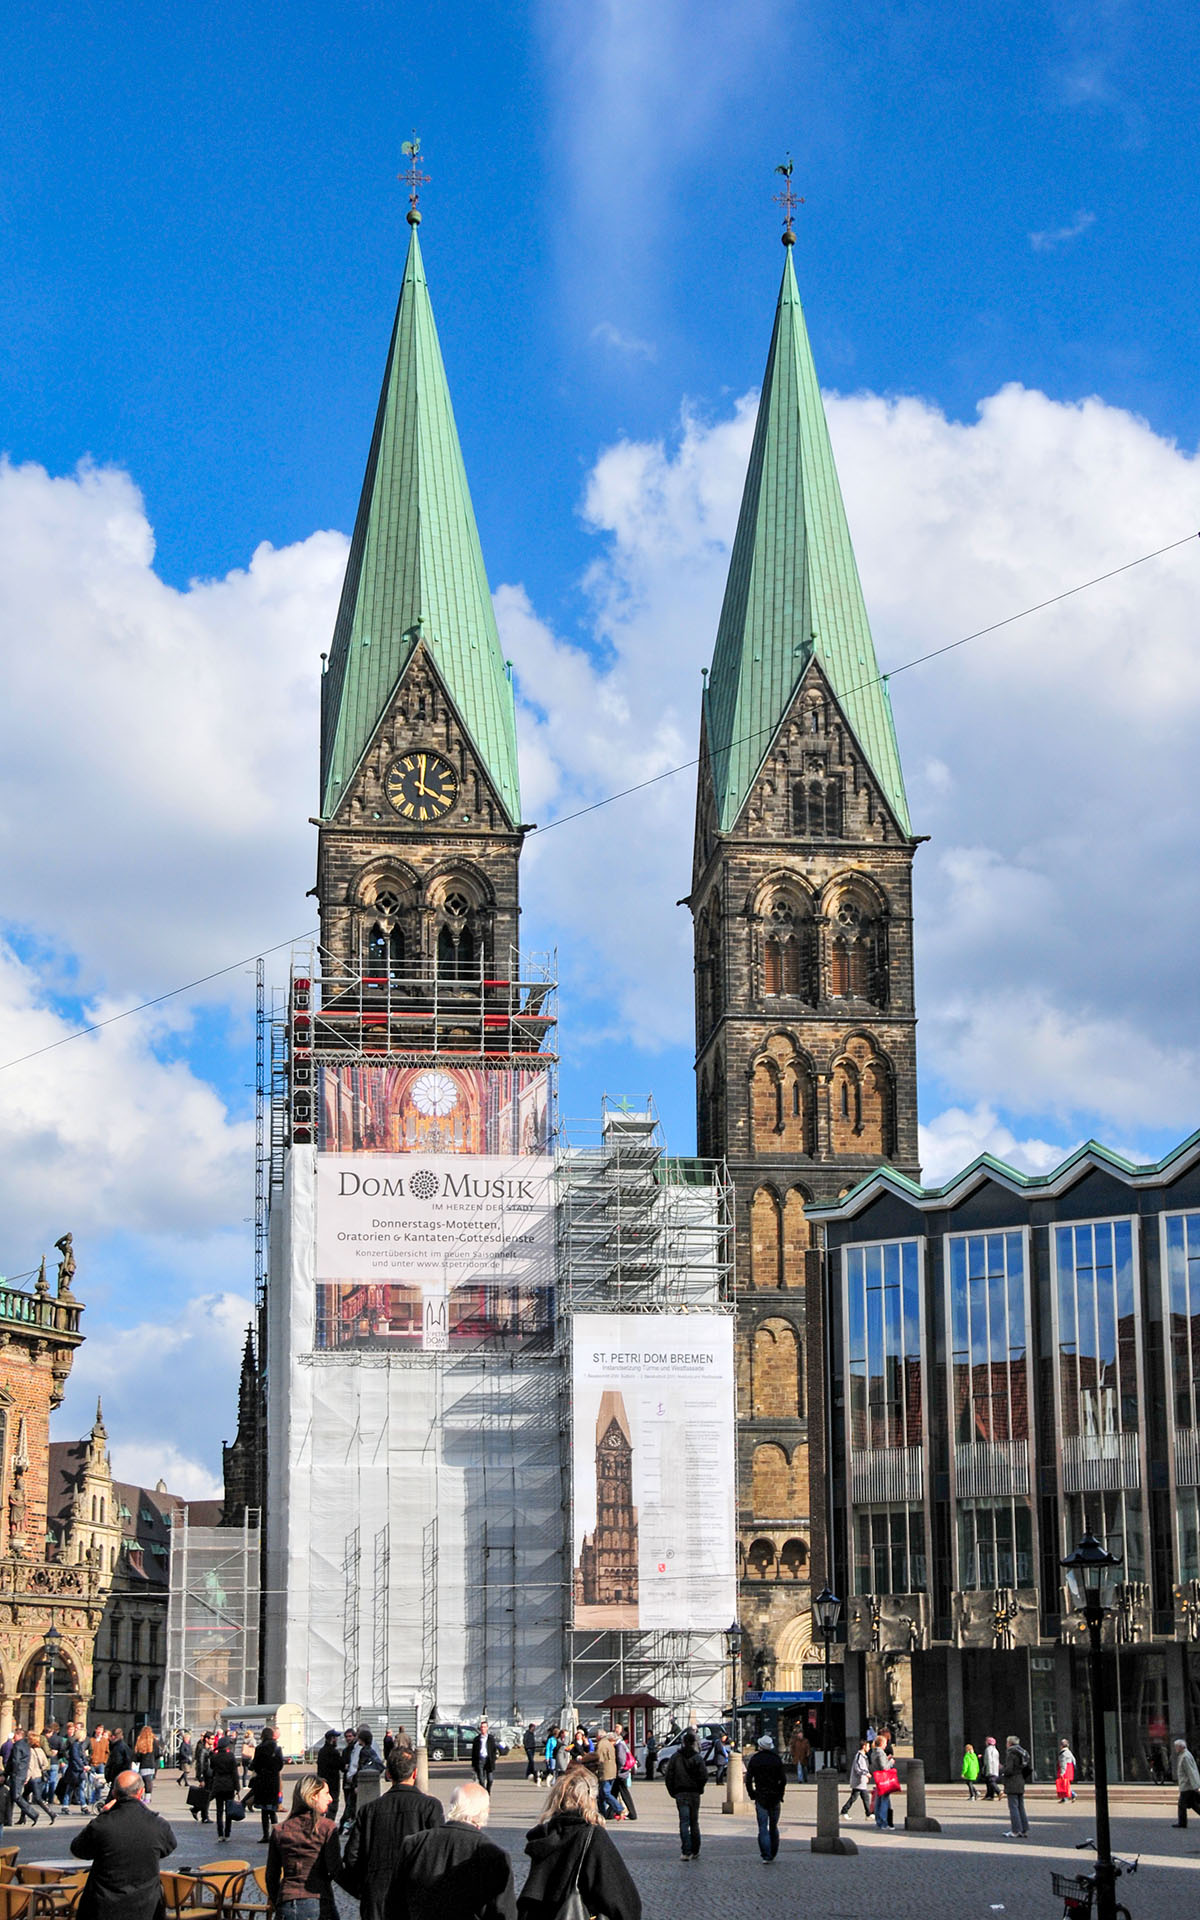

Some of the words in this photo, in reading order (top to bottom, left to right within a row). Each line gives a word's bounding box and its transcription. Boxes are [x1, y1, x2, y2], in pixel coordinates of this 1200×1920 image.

[432, 1203, 443, 1211] IM
[506, 1204, 534, 1212] STADT
[372, 1219, 500, 1230] Donnerstags-Motetten,
[337, 1232, 391, 1241] Oratorien
[404, 1232, 535, 1243] Kantaten-Gottesdienste
[355, 1249, 428, 1257] Konzertübersicht
[416, 1261, 500, 1269] www.stpetridom.de
[592, 1353, 608, 1363] ST.
[610, 1353, 641, 1364] PETRI
[643, 1353, 667, 1364] DOM
[670, 1354, 714, 1364] BREMEN
